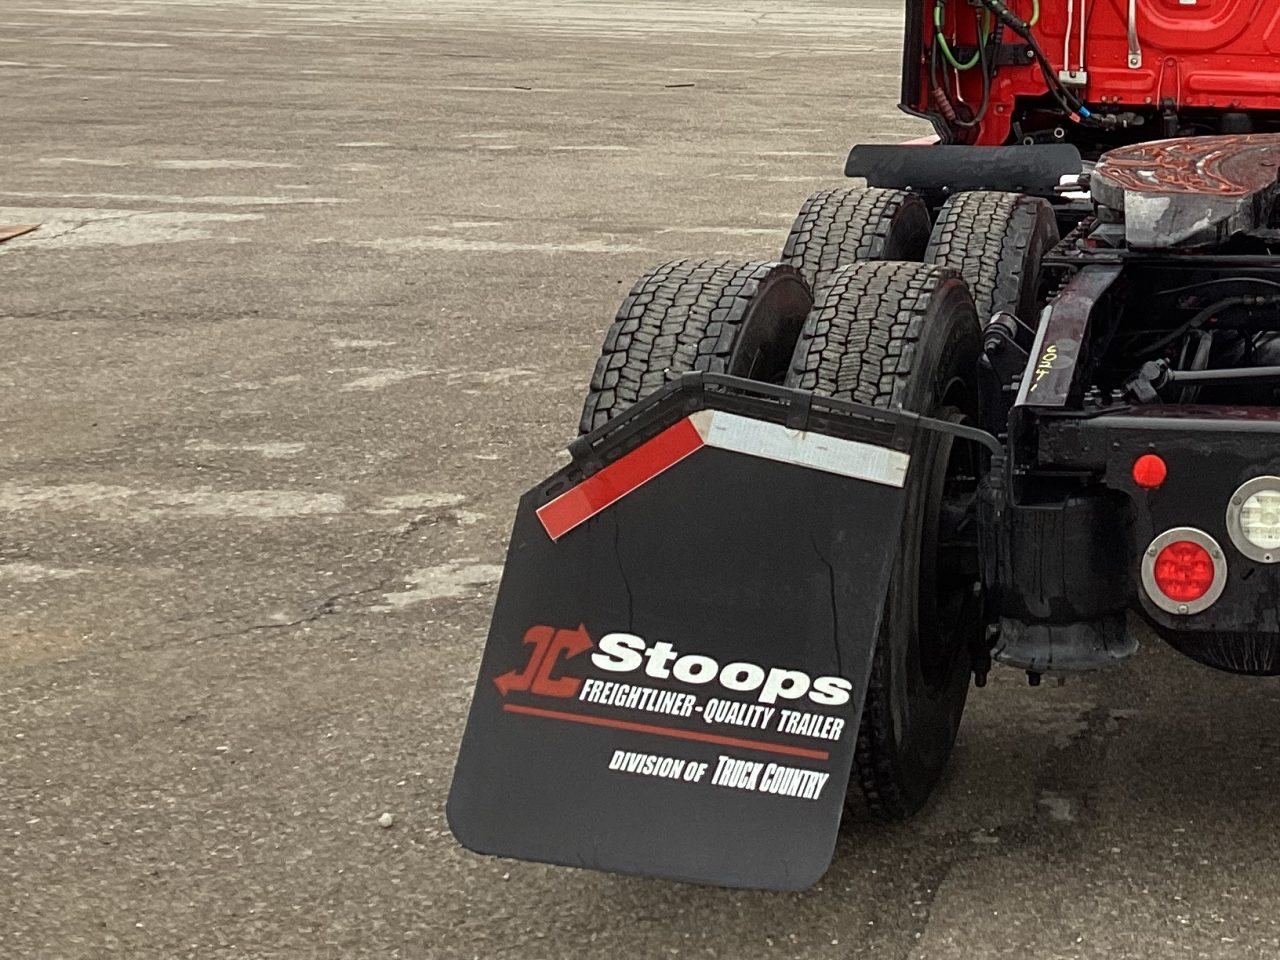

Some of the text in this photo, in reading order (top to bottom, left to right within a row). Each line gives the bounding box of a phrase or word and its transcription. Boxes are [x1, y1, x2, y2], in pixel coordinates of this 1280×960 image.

[591, 632, 852, 706] Stoops
[776, 709, 845, 741] TRAILER
[608, 750, 709, 783] DIVISION OF
[711, 755, 830, 800] TRUCK COUNTRY
